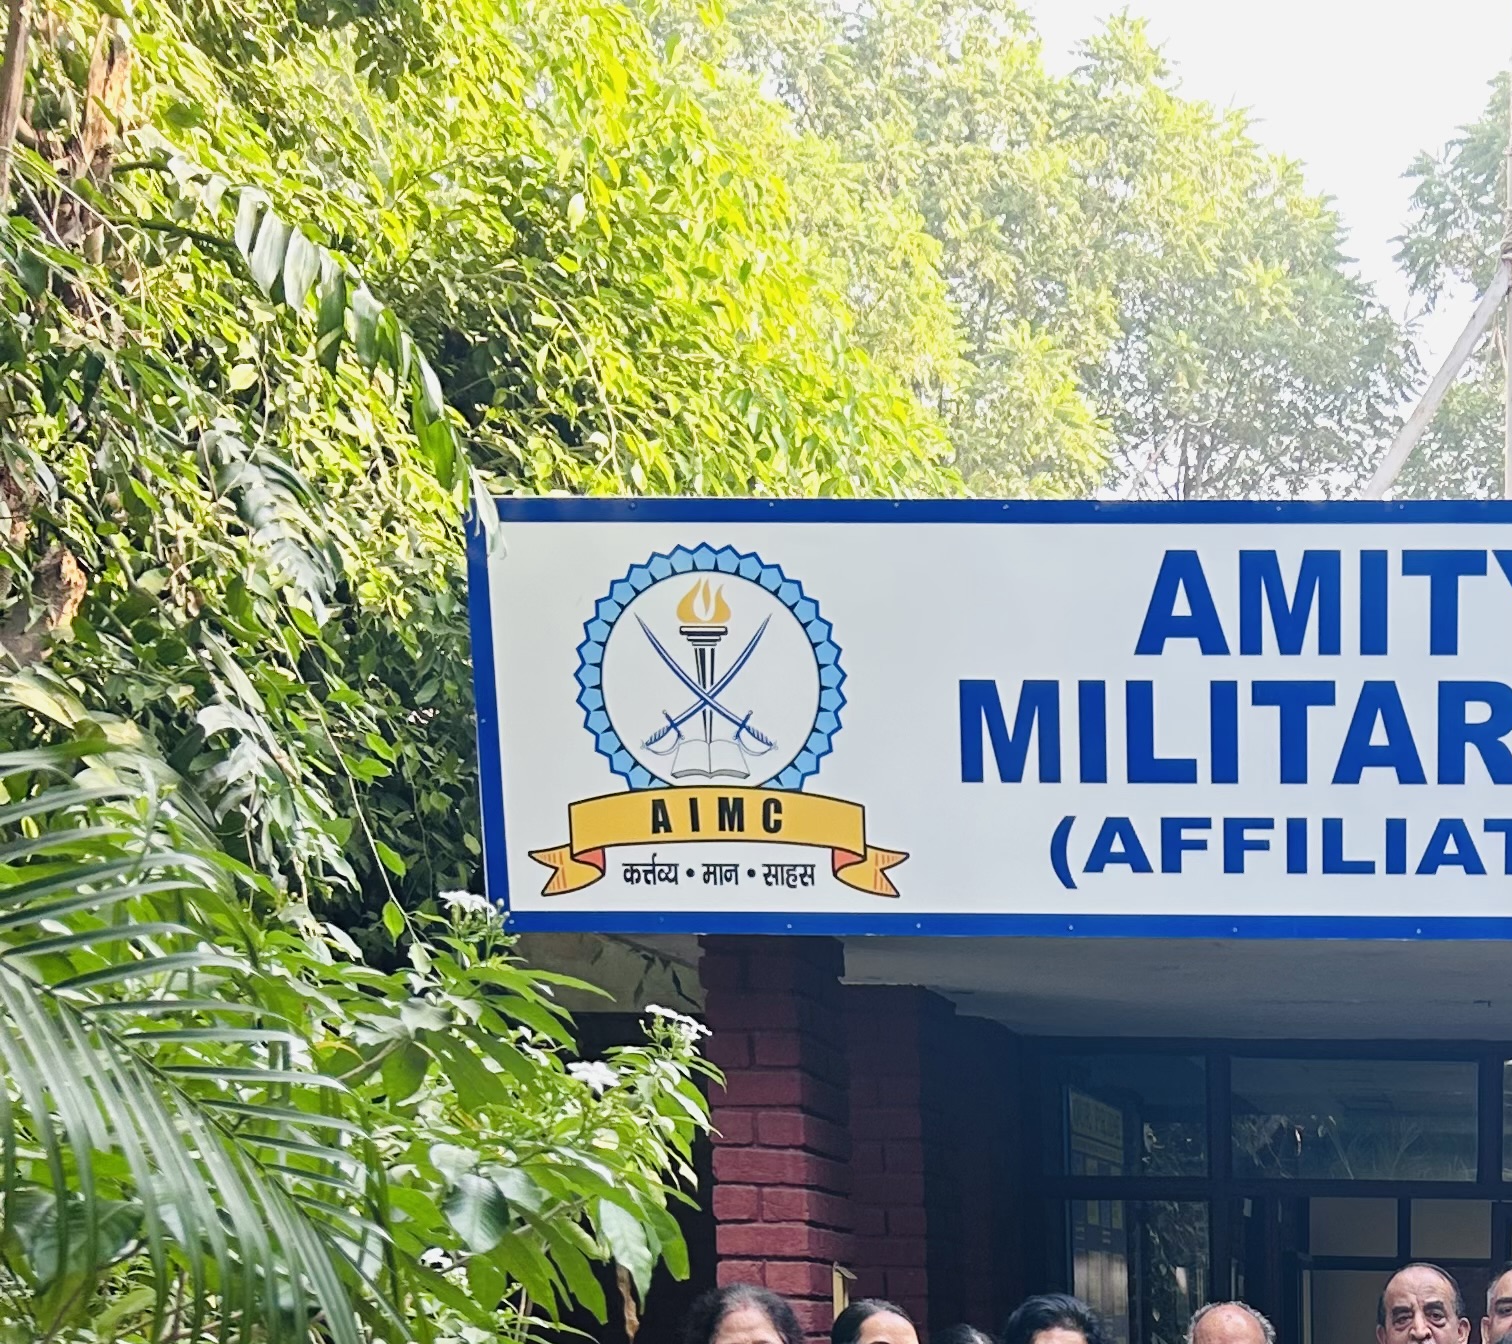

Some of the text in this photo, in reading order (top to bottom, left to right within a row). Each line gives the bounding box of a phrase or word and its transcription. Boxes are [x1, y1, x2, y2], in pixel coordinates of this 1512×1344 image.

[651, 797, 783, 835] AIMC
[702, 863, 739, 885] मान
[762, 864, 815, 888] साहस
